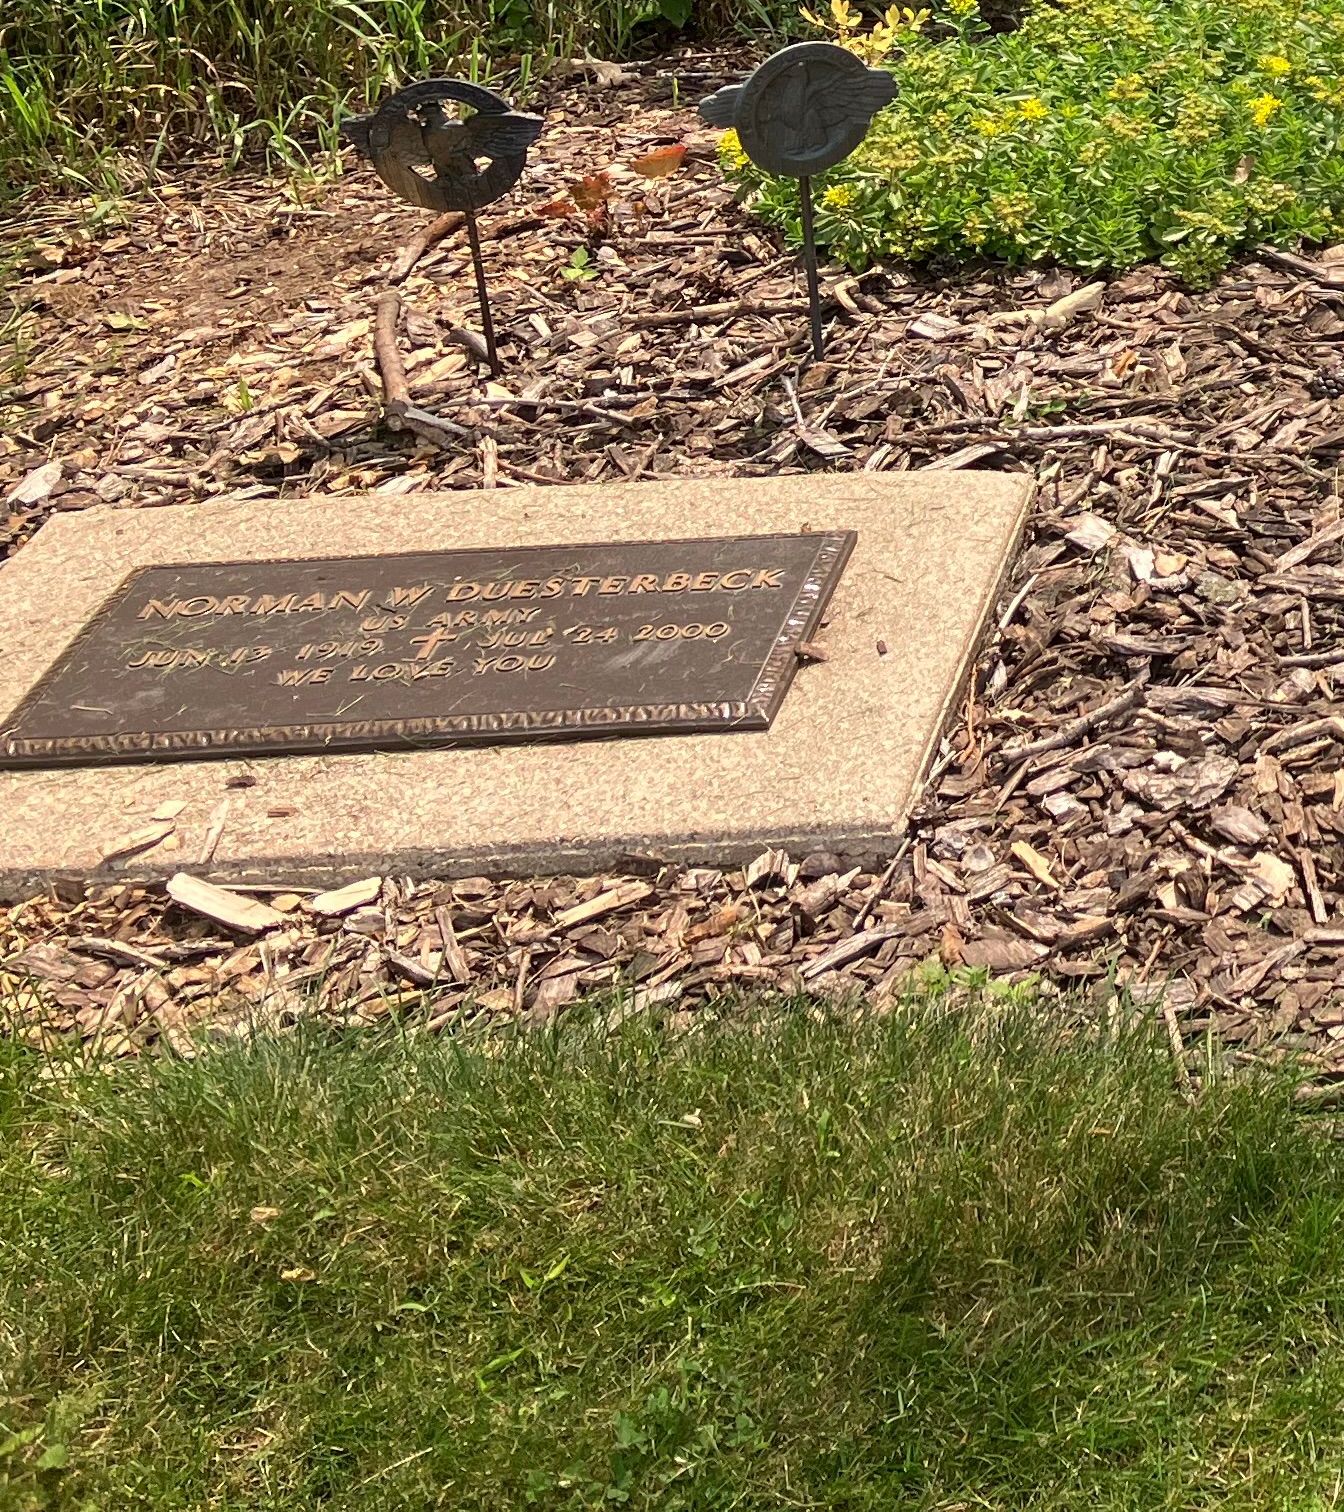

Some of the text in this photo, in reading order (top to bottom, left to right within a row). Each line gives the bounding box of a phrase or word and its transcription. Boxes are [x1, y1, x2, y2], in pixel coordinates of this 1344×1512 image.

[137, 569, 784, 619] NORMAN W DUESTERBECK
[361, 608, 541, 632] US ARMY
[128, 622, 730, 669] JUN 13 1919 JUL 24 2000
[277, 654, 556, 687] WE LOVE YOU
